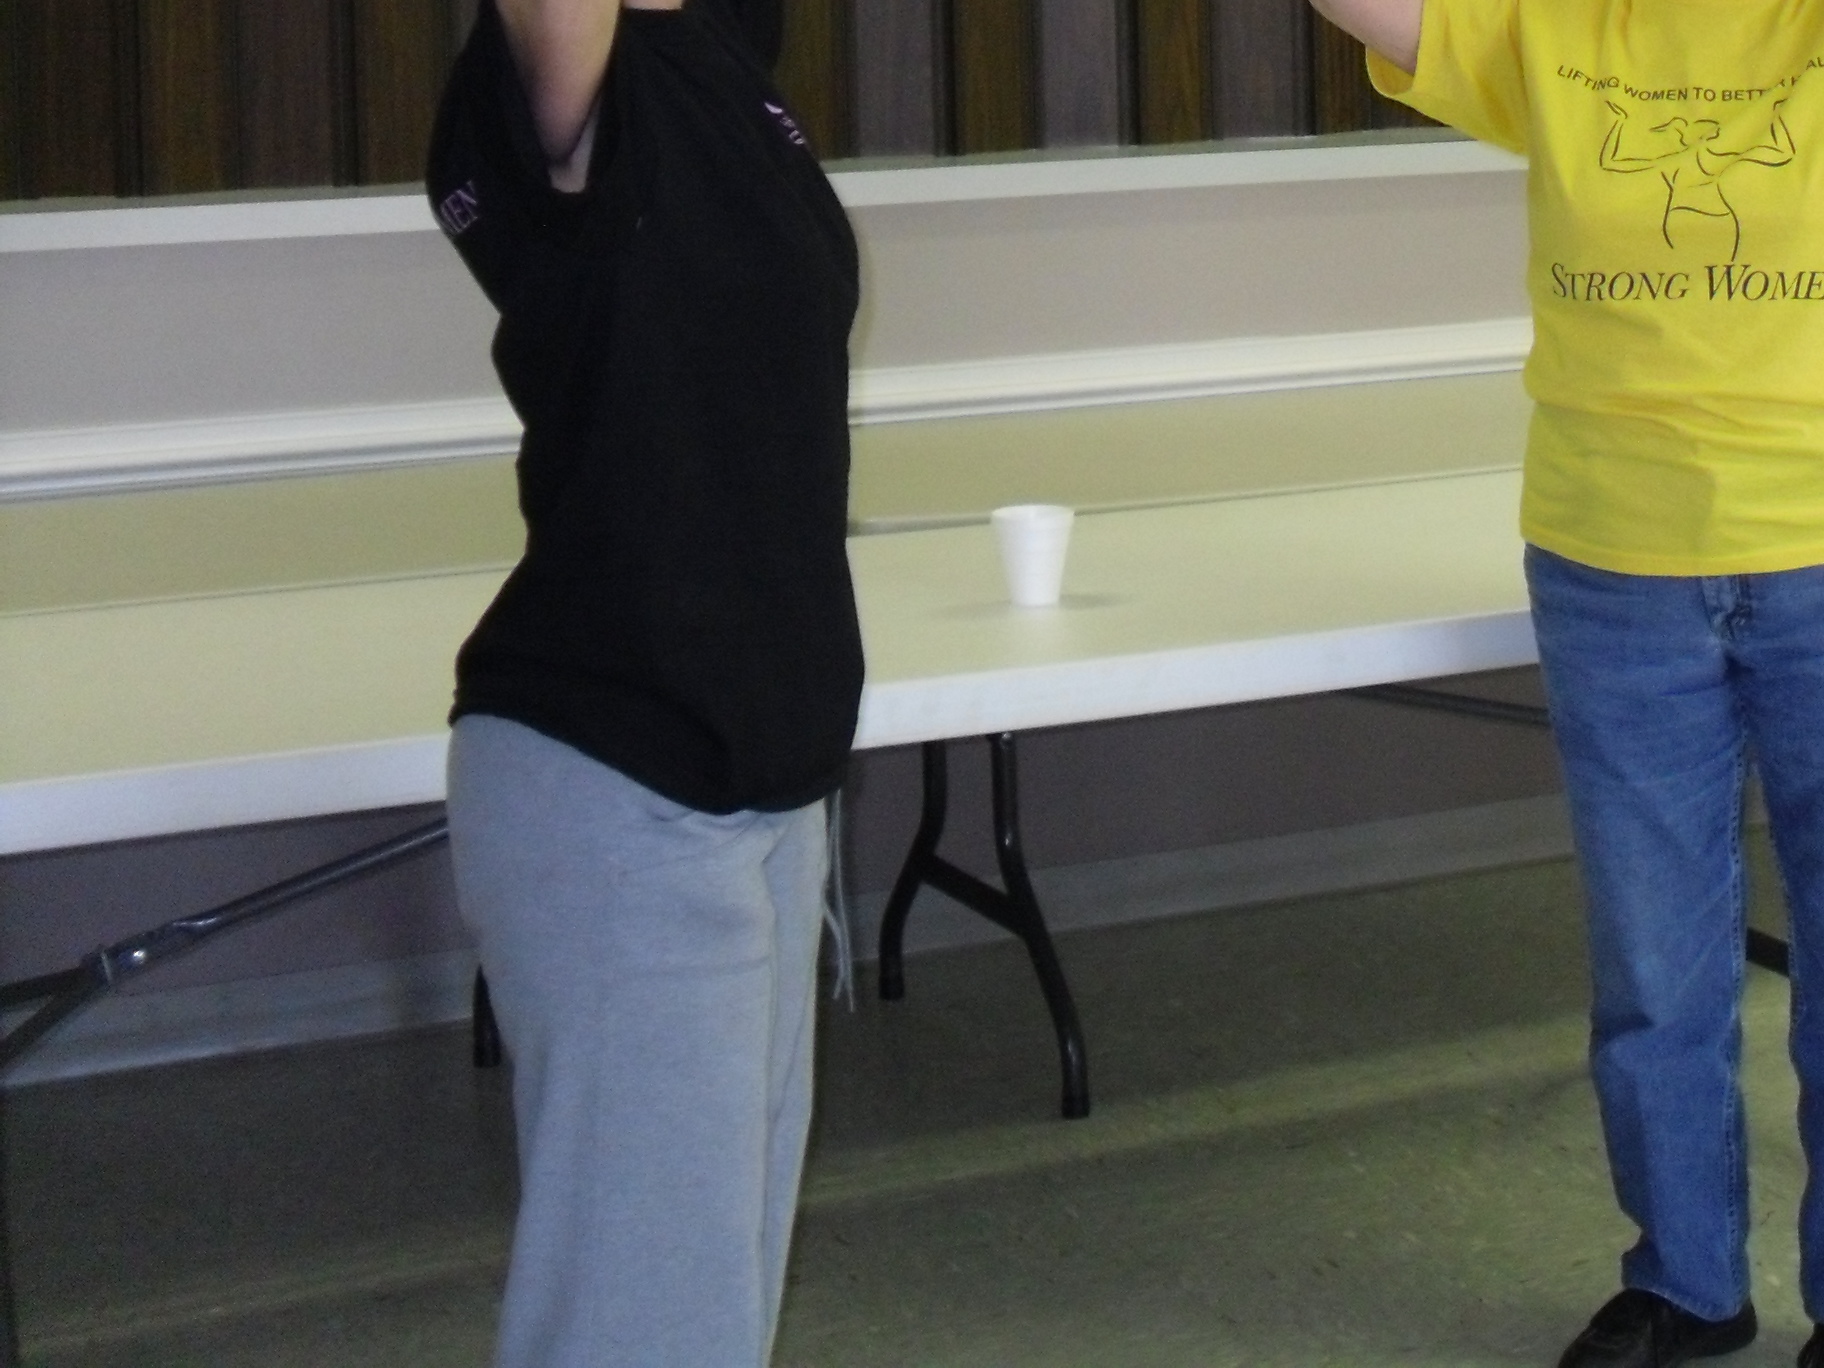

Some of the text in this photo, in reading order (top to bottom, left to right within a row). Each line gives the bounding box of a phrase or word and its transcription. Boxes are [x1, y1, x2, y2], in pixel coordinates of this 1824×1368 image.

[1556, 64, 1620, 91] LIFTING
[1623, 83, 1688, 102] WOMEN
[1692, 86, 1717, 102] TO
[1550, 262, 1691, 302] STRONG
